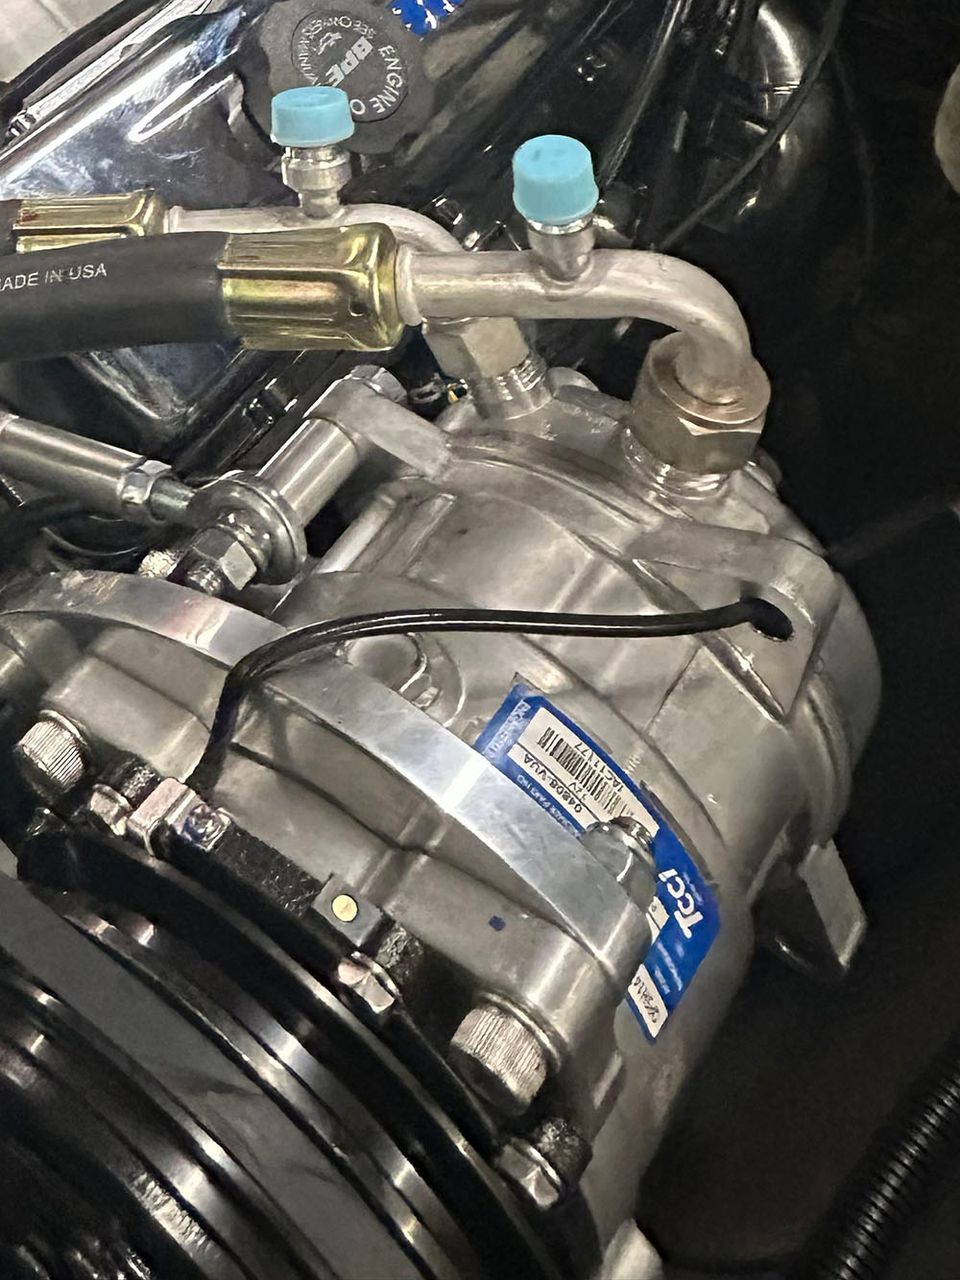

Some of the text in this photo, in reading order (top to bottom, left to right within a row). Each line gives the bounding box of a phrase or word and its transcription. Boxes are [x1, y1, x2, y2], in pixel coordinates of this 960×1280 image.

[378, 45, 404, 114] ENGINE
[44, 268, 65, 285] IN
[68, 263, 108, 281] USA
